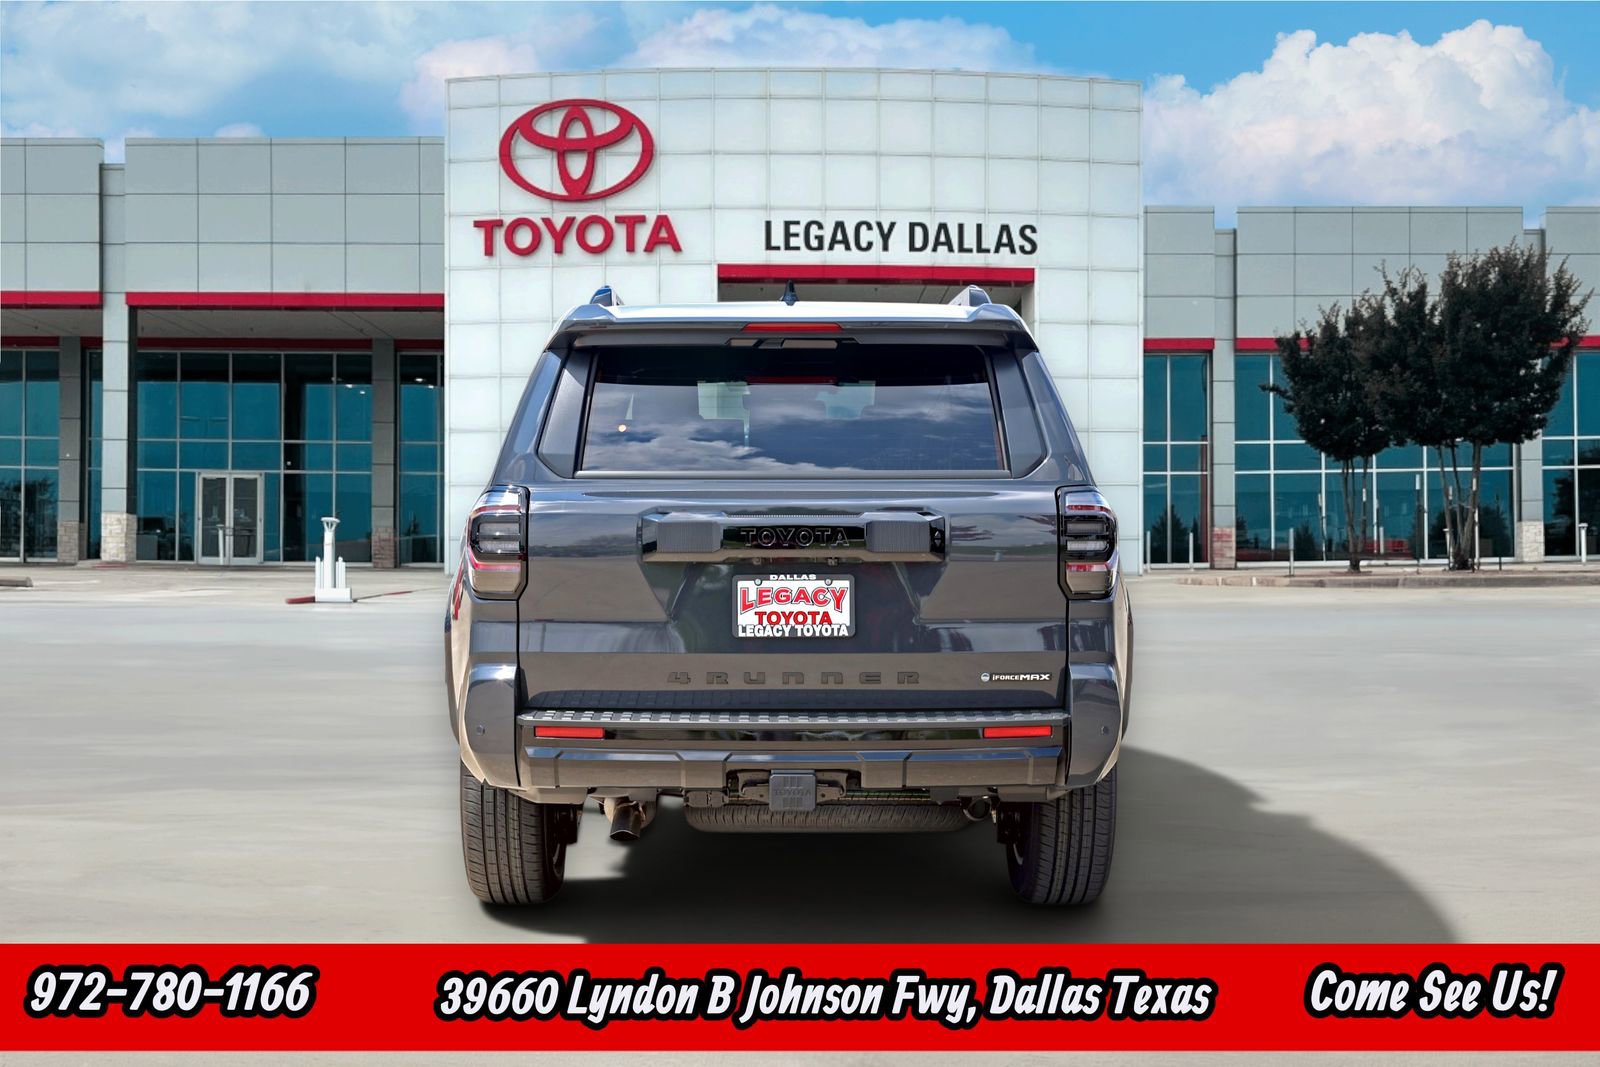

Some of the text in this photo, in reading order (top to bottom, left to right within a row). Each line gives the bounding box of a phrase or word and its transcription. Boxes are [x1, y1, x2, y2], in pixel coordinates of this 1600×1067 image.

[473, 214, 682, 258] TOYOTA
[764, 220, 1038, 255] LEGACY DALLAS
[740, 527, 850, 548] TOYOTA
[739, 586, 849, 615] LEGACY
[754, 611, 833, 626] TOYOTA
[737, 624, 849, 638] LEGACY TOYOTA
[667, 671, 922, 685] 4RUNNER
